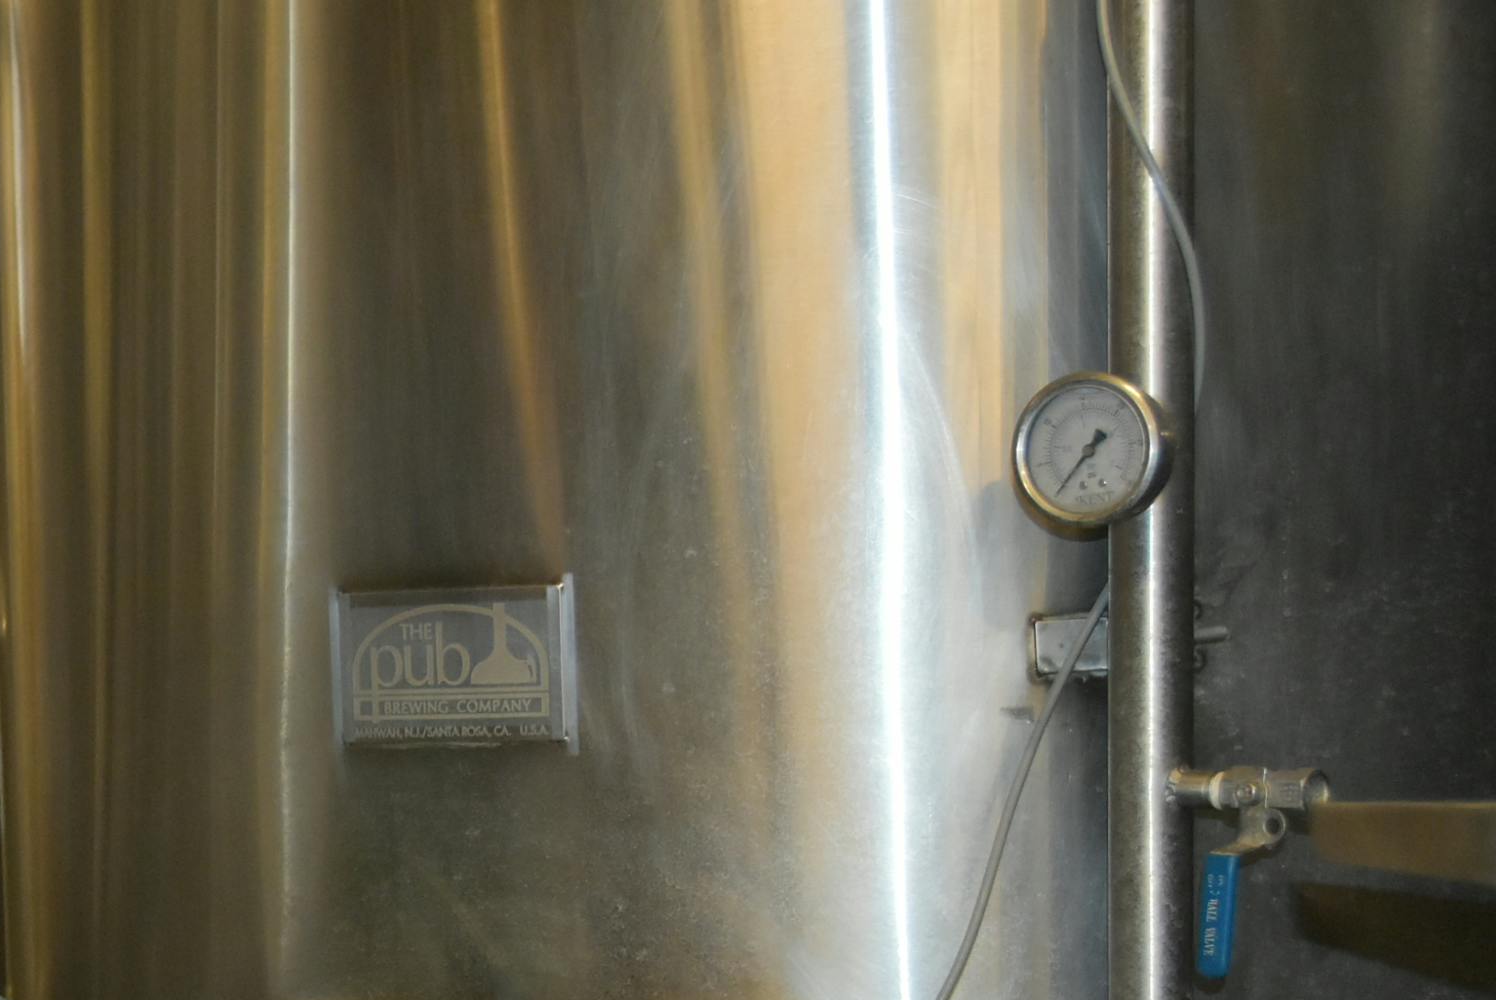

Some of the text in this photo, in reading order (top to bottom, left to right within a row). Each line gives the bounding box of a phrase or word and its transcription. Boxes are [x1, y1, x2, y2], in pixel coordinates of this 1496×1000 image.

[399, 623, 433, 641] THE
[370, 621, 471, 722] pub
[384, 699, 532, 715] BREWING COMPANY
